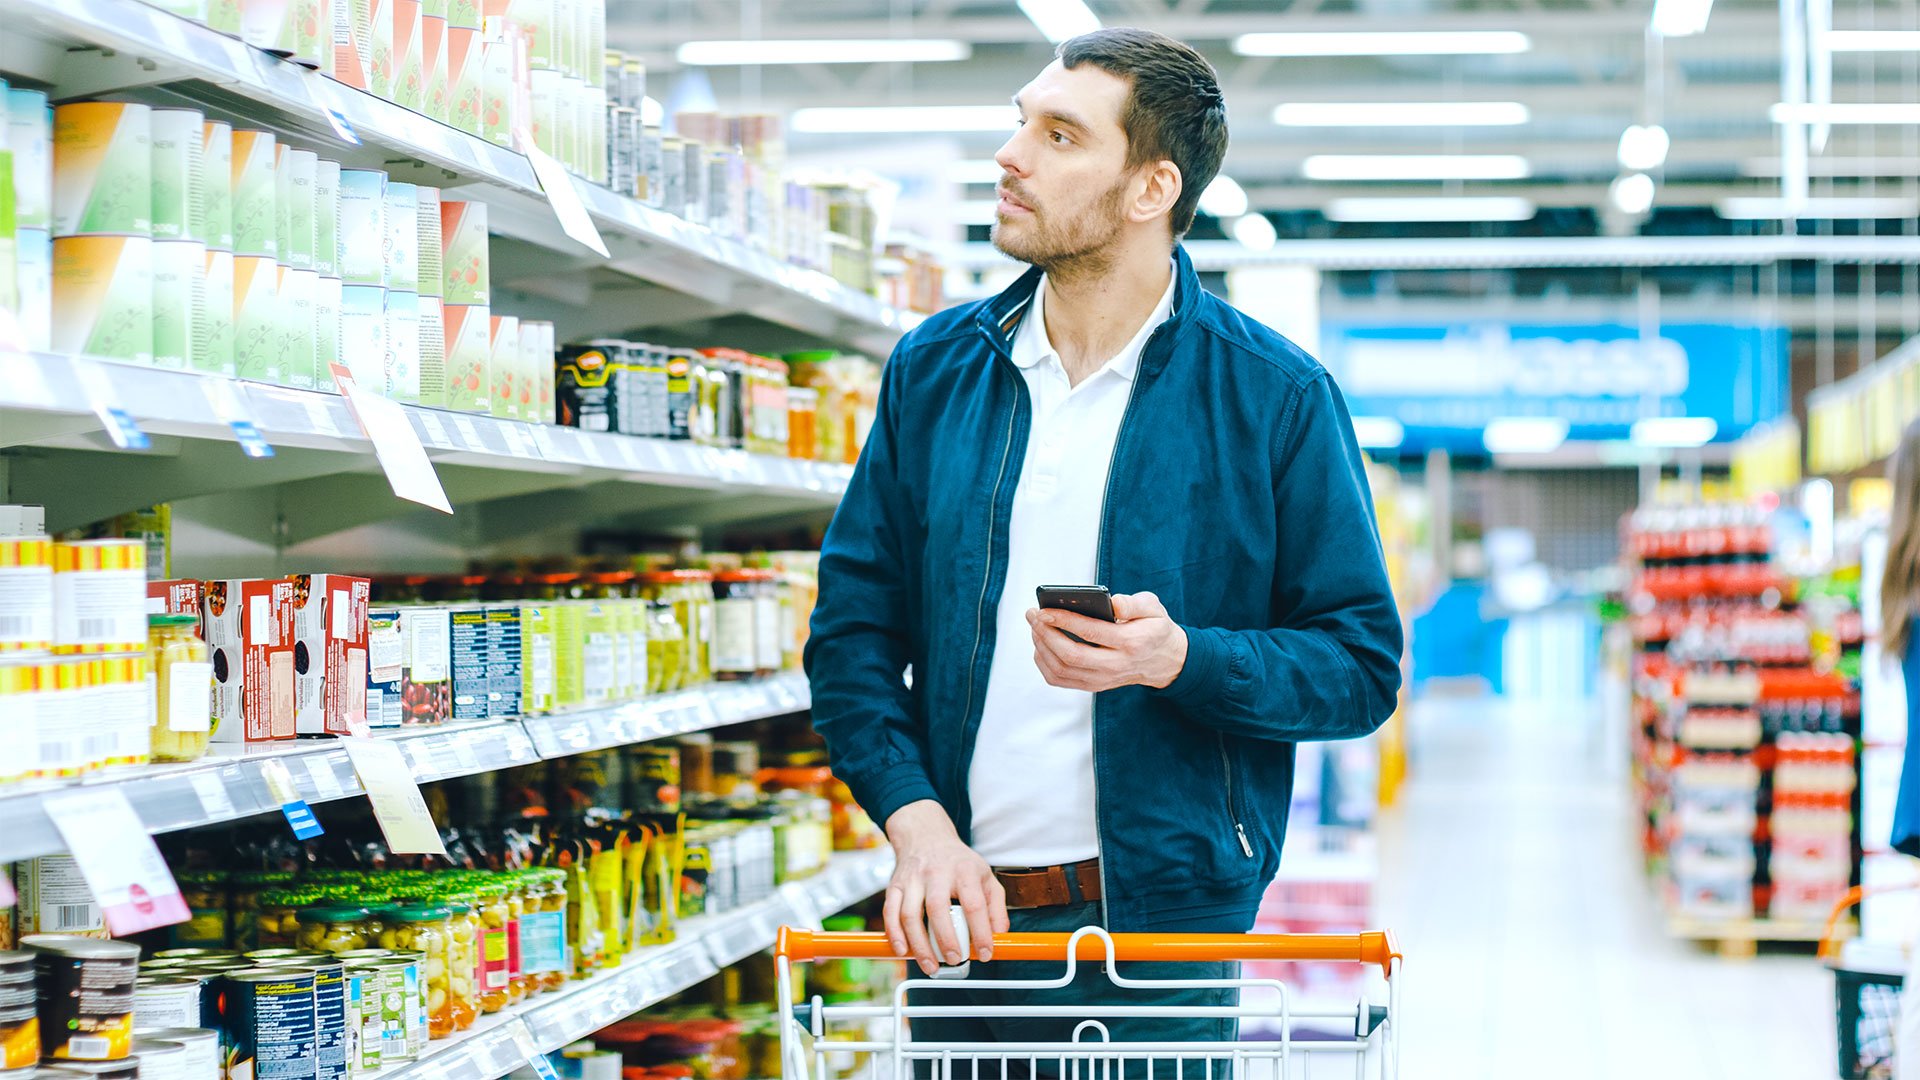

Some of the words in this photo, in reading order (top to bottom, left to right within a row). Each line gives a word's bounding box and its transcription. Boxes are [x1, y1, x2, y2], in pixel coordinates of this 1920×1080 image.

[153, 140, 176, 150] NEW
[293, 177, 309, 187] NEW
[317, 186, 329, 196] EW
